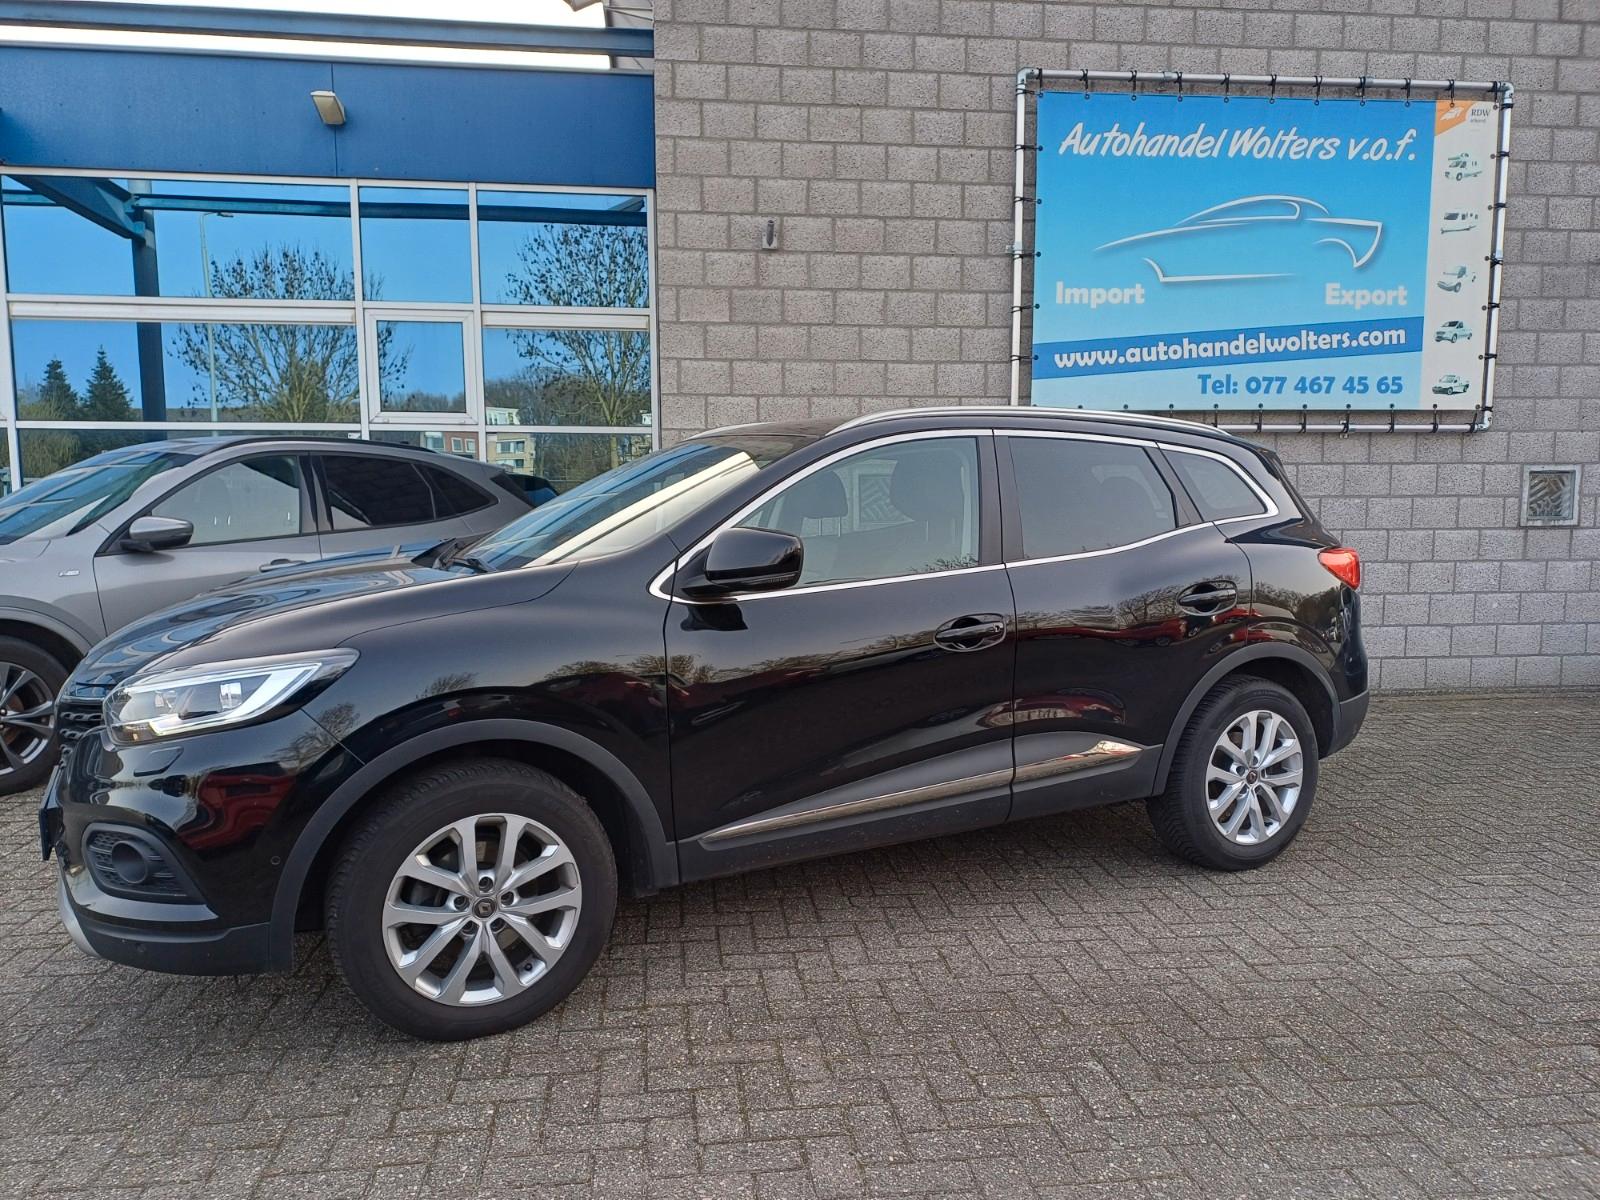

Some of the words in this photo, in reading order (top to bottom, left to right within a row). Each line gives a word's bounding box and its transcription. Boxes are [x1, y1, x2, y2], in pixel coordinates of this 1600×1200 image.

[1058, 121, 1229, 160] Autohandel
[1227, 126, 1342, 160] Wolters
[1347, 128, 1418, 162] v.o.f.
[1055, 281, 1147, 309] Import
[1324, 282, 1409, 309] Export
[1054, 328, 1406, 368] www.autohandelwolters.com
[1198, 374, 1239, 395] Tel:
[1245, 375, 1286, 395] 077
[1293, 376, 1337, 395] 467
[1342, 375, 1370, 395] 45
[1376, 375, 1404, 395] 65
